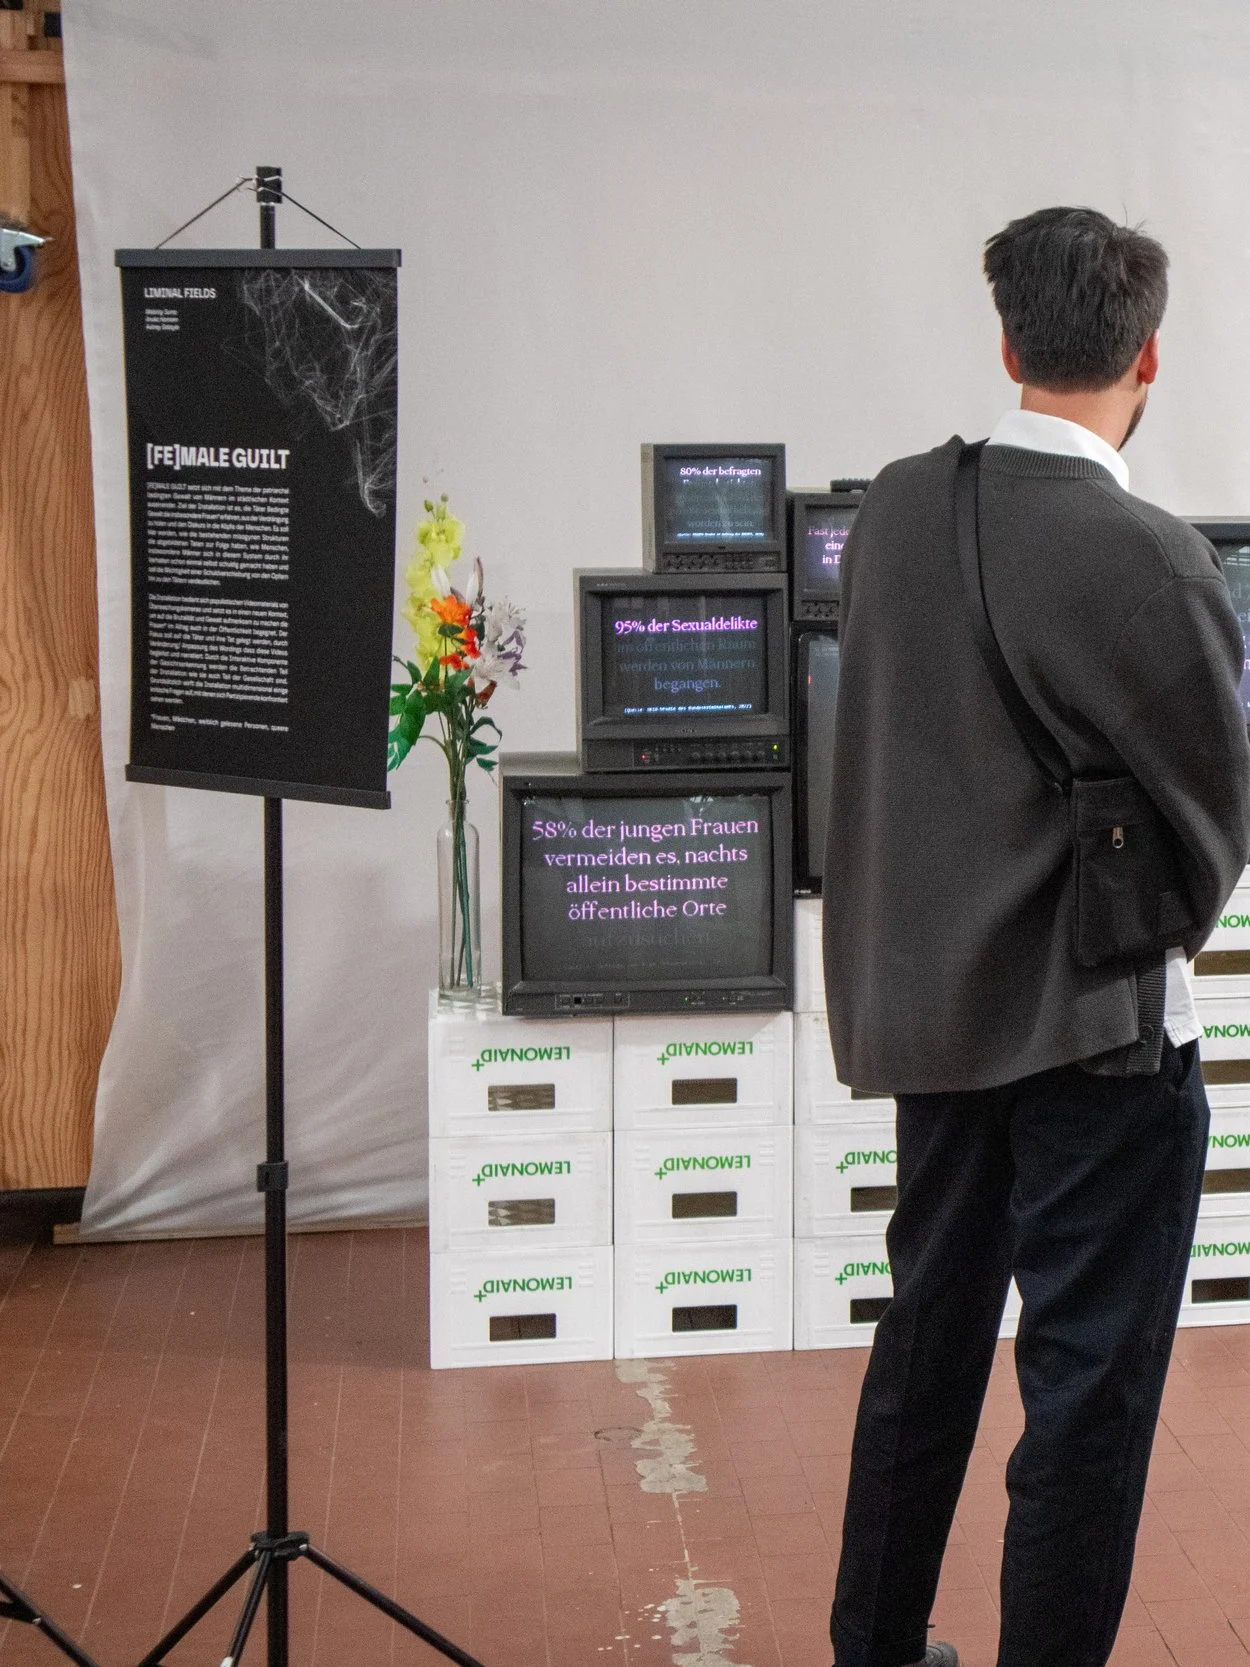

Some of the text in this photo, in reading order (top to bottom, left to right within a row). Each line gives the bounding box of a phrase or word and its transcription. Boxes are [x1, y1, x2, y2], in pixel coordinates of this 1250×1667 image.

[144, 287, 216, 299] LIMINAL FIELDS
[146, 443, 290, 470] [FE]MALE GUILT
[680, 466, 761, 478] 80% der befragten
[614, 615, 758, 635] 95% der Sexualdelikte
[654, 677, 721, 693] begangen.
[531, 817, 759, 843] 58% der jungen Frauen
[543, 846, 651, 867] vermeiden
[684, 843, 748, 863] nachts
[566, 873, 728, 893] allein bestimmte
[568, 899, 727, 921] öffentliche Orte
